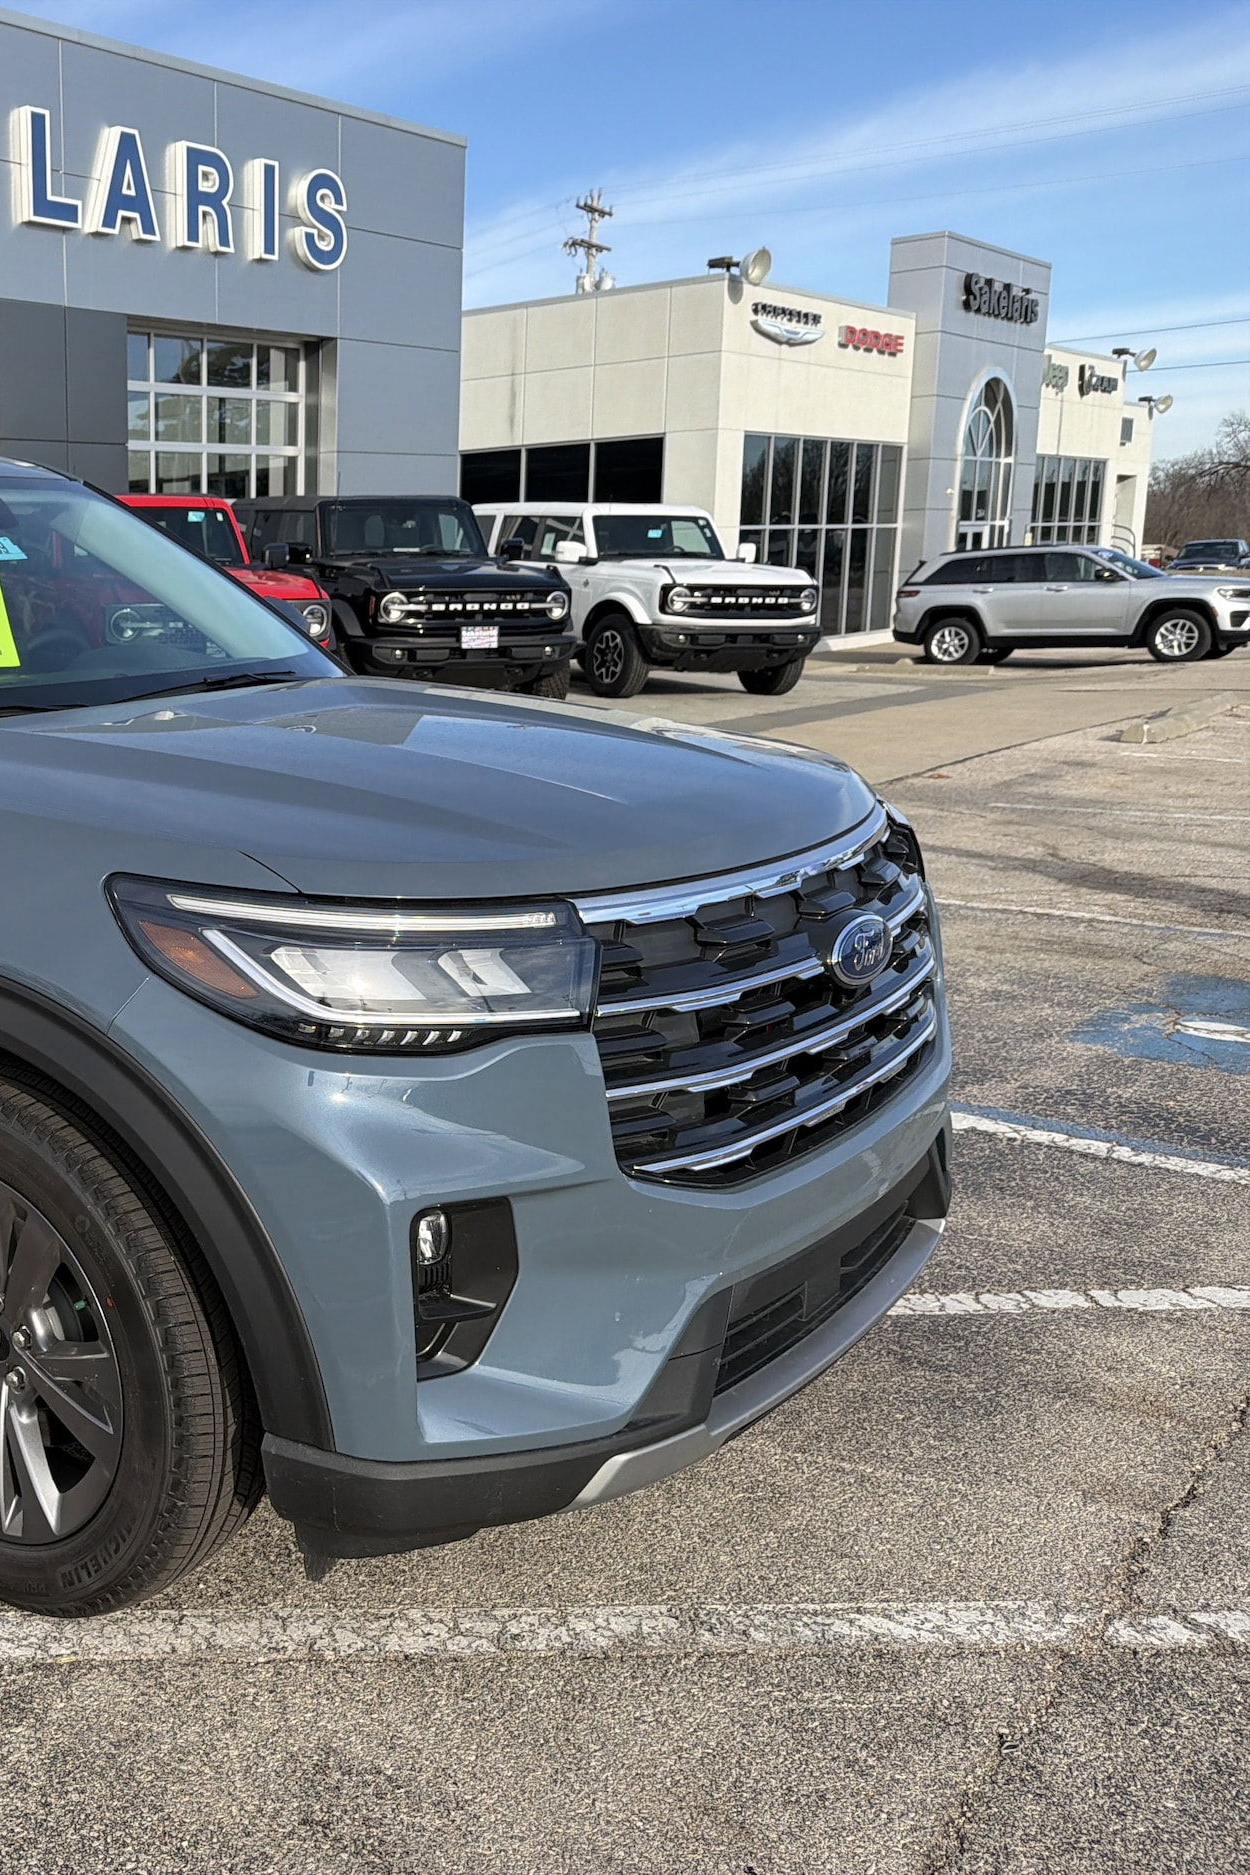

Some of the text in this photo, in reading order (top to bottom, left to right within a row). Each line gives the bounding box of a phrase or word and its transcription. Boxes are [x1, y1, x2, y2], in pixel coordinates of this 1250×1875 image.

[842, 325, 904, 355] DODGE
[431, 602, 530, 611] BRONCO
[710, 596, 789, 604] BRONCO
[854, 928, 885, 971] Ford
